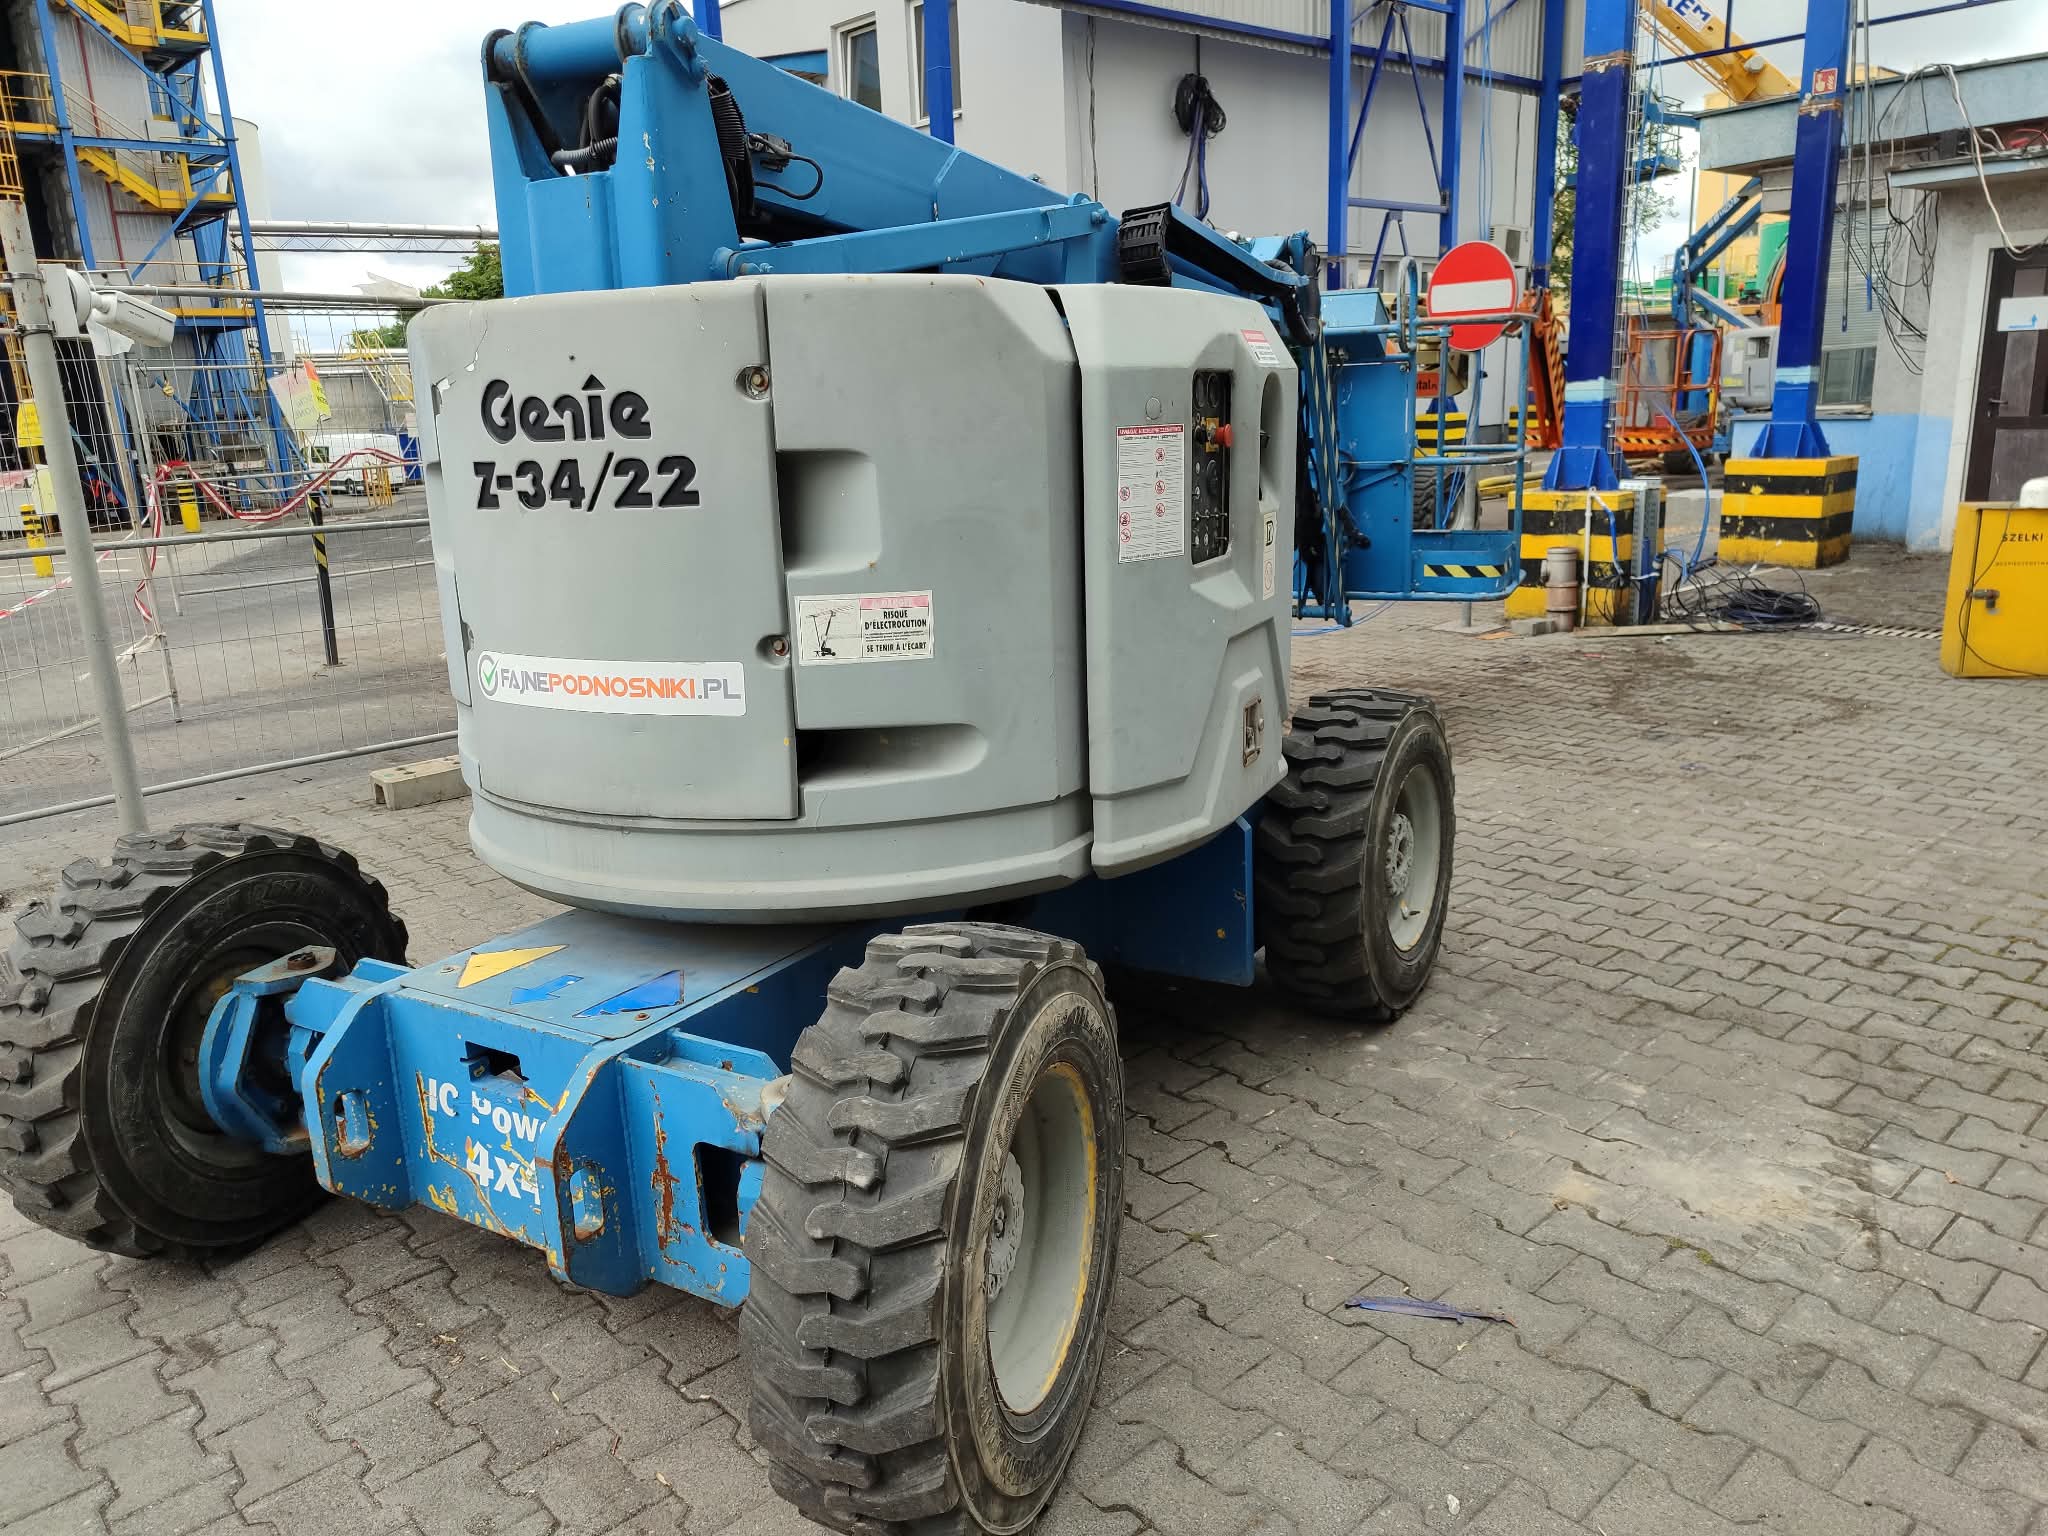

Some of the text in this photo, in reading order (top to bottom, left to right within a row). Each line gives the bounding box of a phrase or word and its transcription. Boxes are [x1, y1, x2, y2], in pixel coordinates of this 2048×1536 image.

[1668, 0, 1711, 22] EM
[481, 374, 651, 444] Genie
[473, 451, 700, 512] Z-34/22
[2003, 533, 2043, 542] SZELKI
[883, 609, 908, 619] RISQUE
[864, 618, 927, 630] D'ÉLECTROCUTION
[866, 645, 874, 653] SE
[876, 643, 894, 652] TENIR
[501, 668, 741, 700] FAJNEPODNOSNIKI.PL
